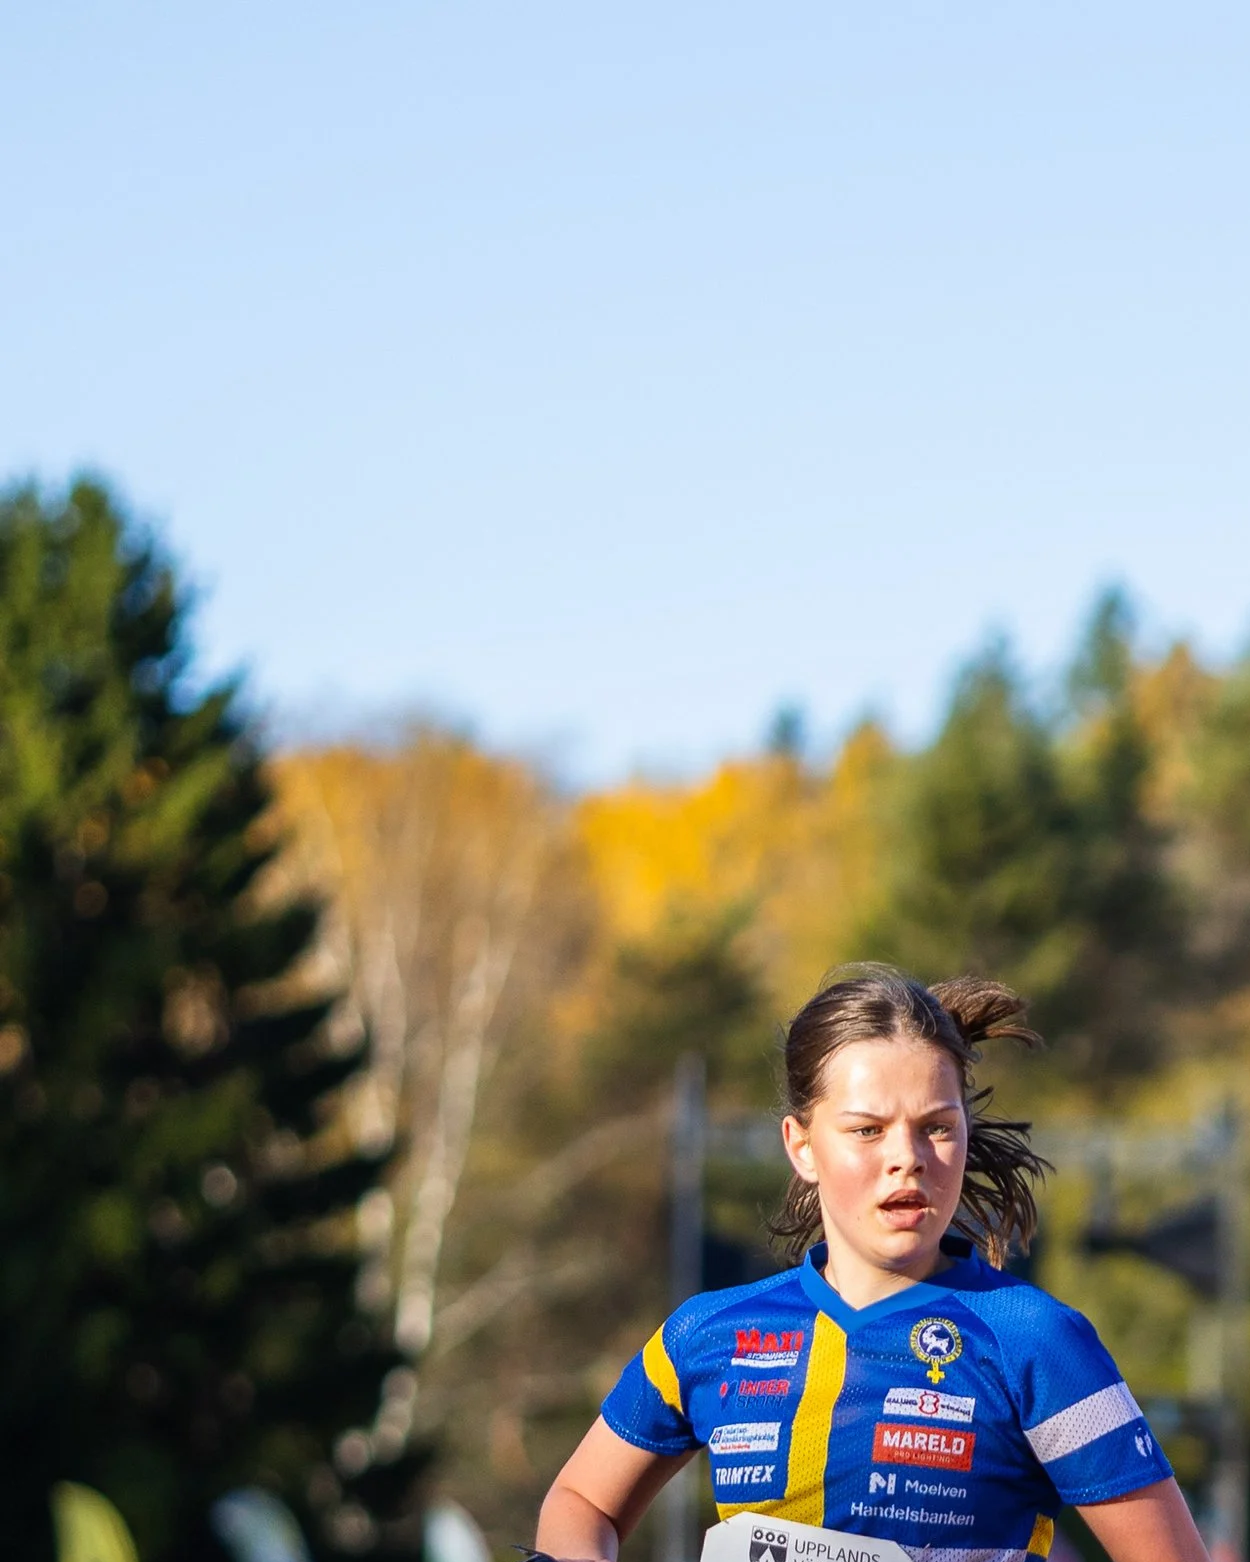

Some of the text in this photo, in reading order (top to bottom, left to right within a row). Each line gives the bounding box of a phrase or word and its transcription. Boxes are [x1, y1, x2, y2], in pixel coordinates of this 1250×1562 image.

[735, 1329, 804, 1353] MAXI
[739, 1379, 790, 1396] INTER
[882, 1430, 966, 1455] MARELD
[894, 1451, 910, 1459] PRO
[715, 1464, 776, 1486] TRIMTEX
[904, 1479, 967, 1499] Moelven
[850, 1501, 976, 1526] Handelsbanken
